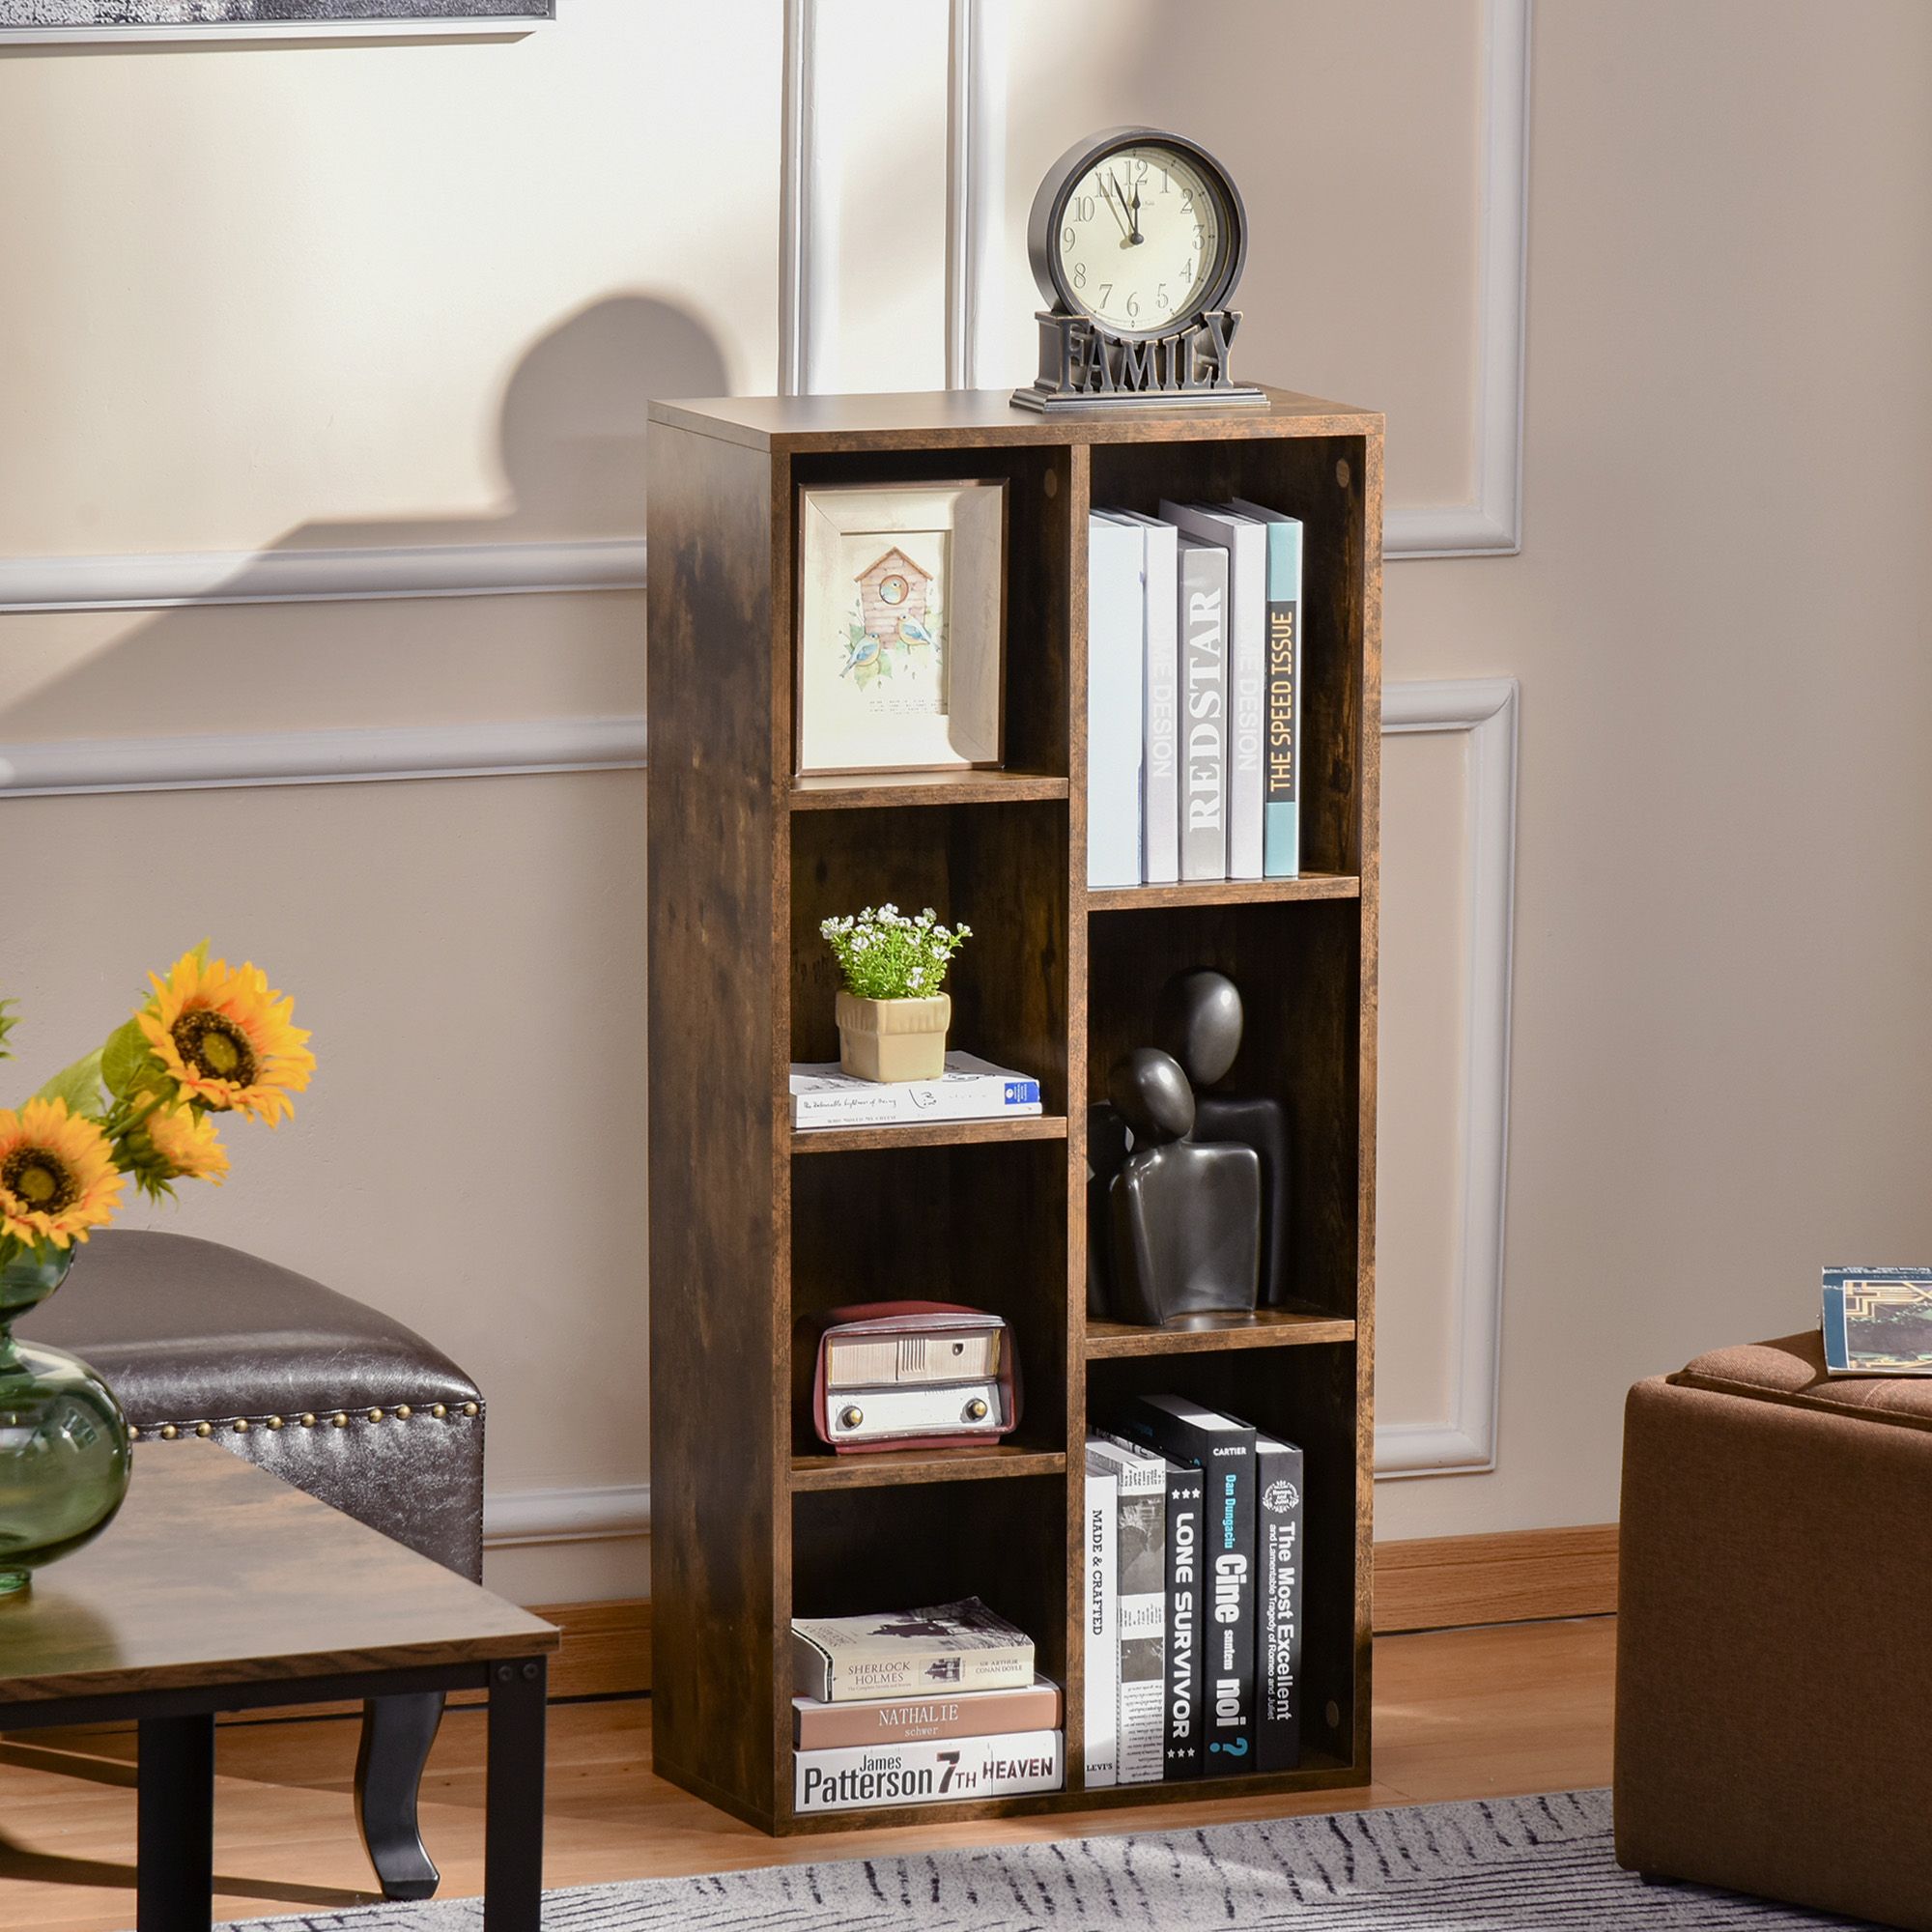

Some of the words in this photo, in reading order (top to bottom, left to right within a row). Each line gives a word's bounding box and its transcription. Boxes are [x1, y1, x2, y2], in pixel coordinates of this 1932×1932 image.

[1094, 172, 1117, 198] 11
[1123, 159, 1149, 186] 12
[1159, 168, 1171, 194] 1
[1073, 196, 1095, 222] 10
[1179, 188, 1194, 214] 2
[1063, 227, 1076, 253] 9
[1192, 224, 1206, 250] 3
[1073, 263, 1087, 289] 8
[1179, 258, 1192, 284] 4
[1098, 284, 1113, 309] 7
[1126, 292, 1139, 318] 6
[1156, 283, 1169, 309] 5
[1057, 311, 1243, 394] FAMILY
[1271, 611, 1293, 675] ISSUE
[1188, 586, 1222, 832] REDSTAR
[1270, 681, 1292, 746] SPEED
[1270, 751, 1292, 792] THE
[1212, 1447, 1247, 1456] CARTIER
[1225, 1474, 1236, 1495] Dan
[1093, 1510, 1103, 1552] MADE
[1268, 1523, 1278, 1542] and
[1277, 1520, 1295, 1562] The
[1175, 1513, 1194, 1583] LONE
[1093, 1556, 1103, 1567] &
[1214, 1553, 1247, 1624] Cine
[1277, 1567, 1295, 1620] Most
[1093, 1570, 1103, 1635] CRAFTED
[1266, 1596, 1277, 1633] Tragedy
[1267, 1634, 1276, 1643] of
[848, 1662, 911, 1676] SHERLOCK
[1172, 1591, 1193, 1739] SURVIVOR
[1267, 1644, 1276, 1677] Romeo
[1276, 1624, 1294, 1720] Excellent
[855, 1672, 904, 1685] HOLMES
[1267, 1678, 1276, 1695] and
[879, 1704, 959, 1727] NATHALIE
[1215, 1678, 1247, 1727] noi
[904, 1725, 939, 1737] schwer
[859, 1754, 902, 1773] James
[982, 1756, 1054, 1779] HEAVEN
[804, 1766, 933, 1804] Patterson
